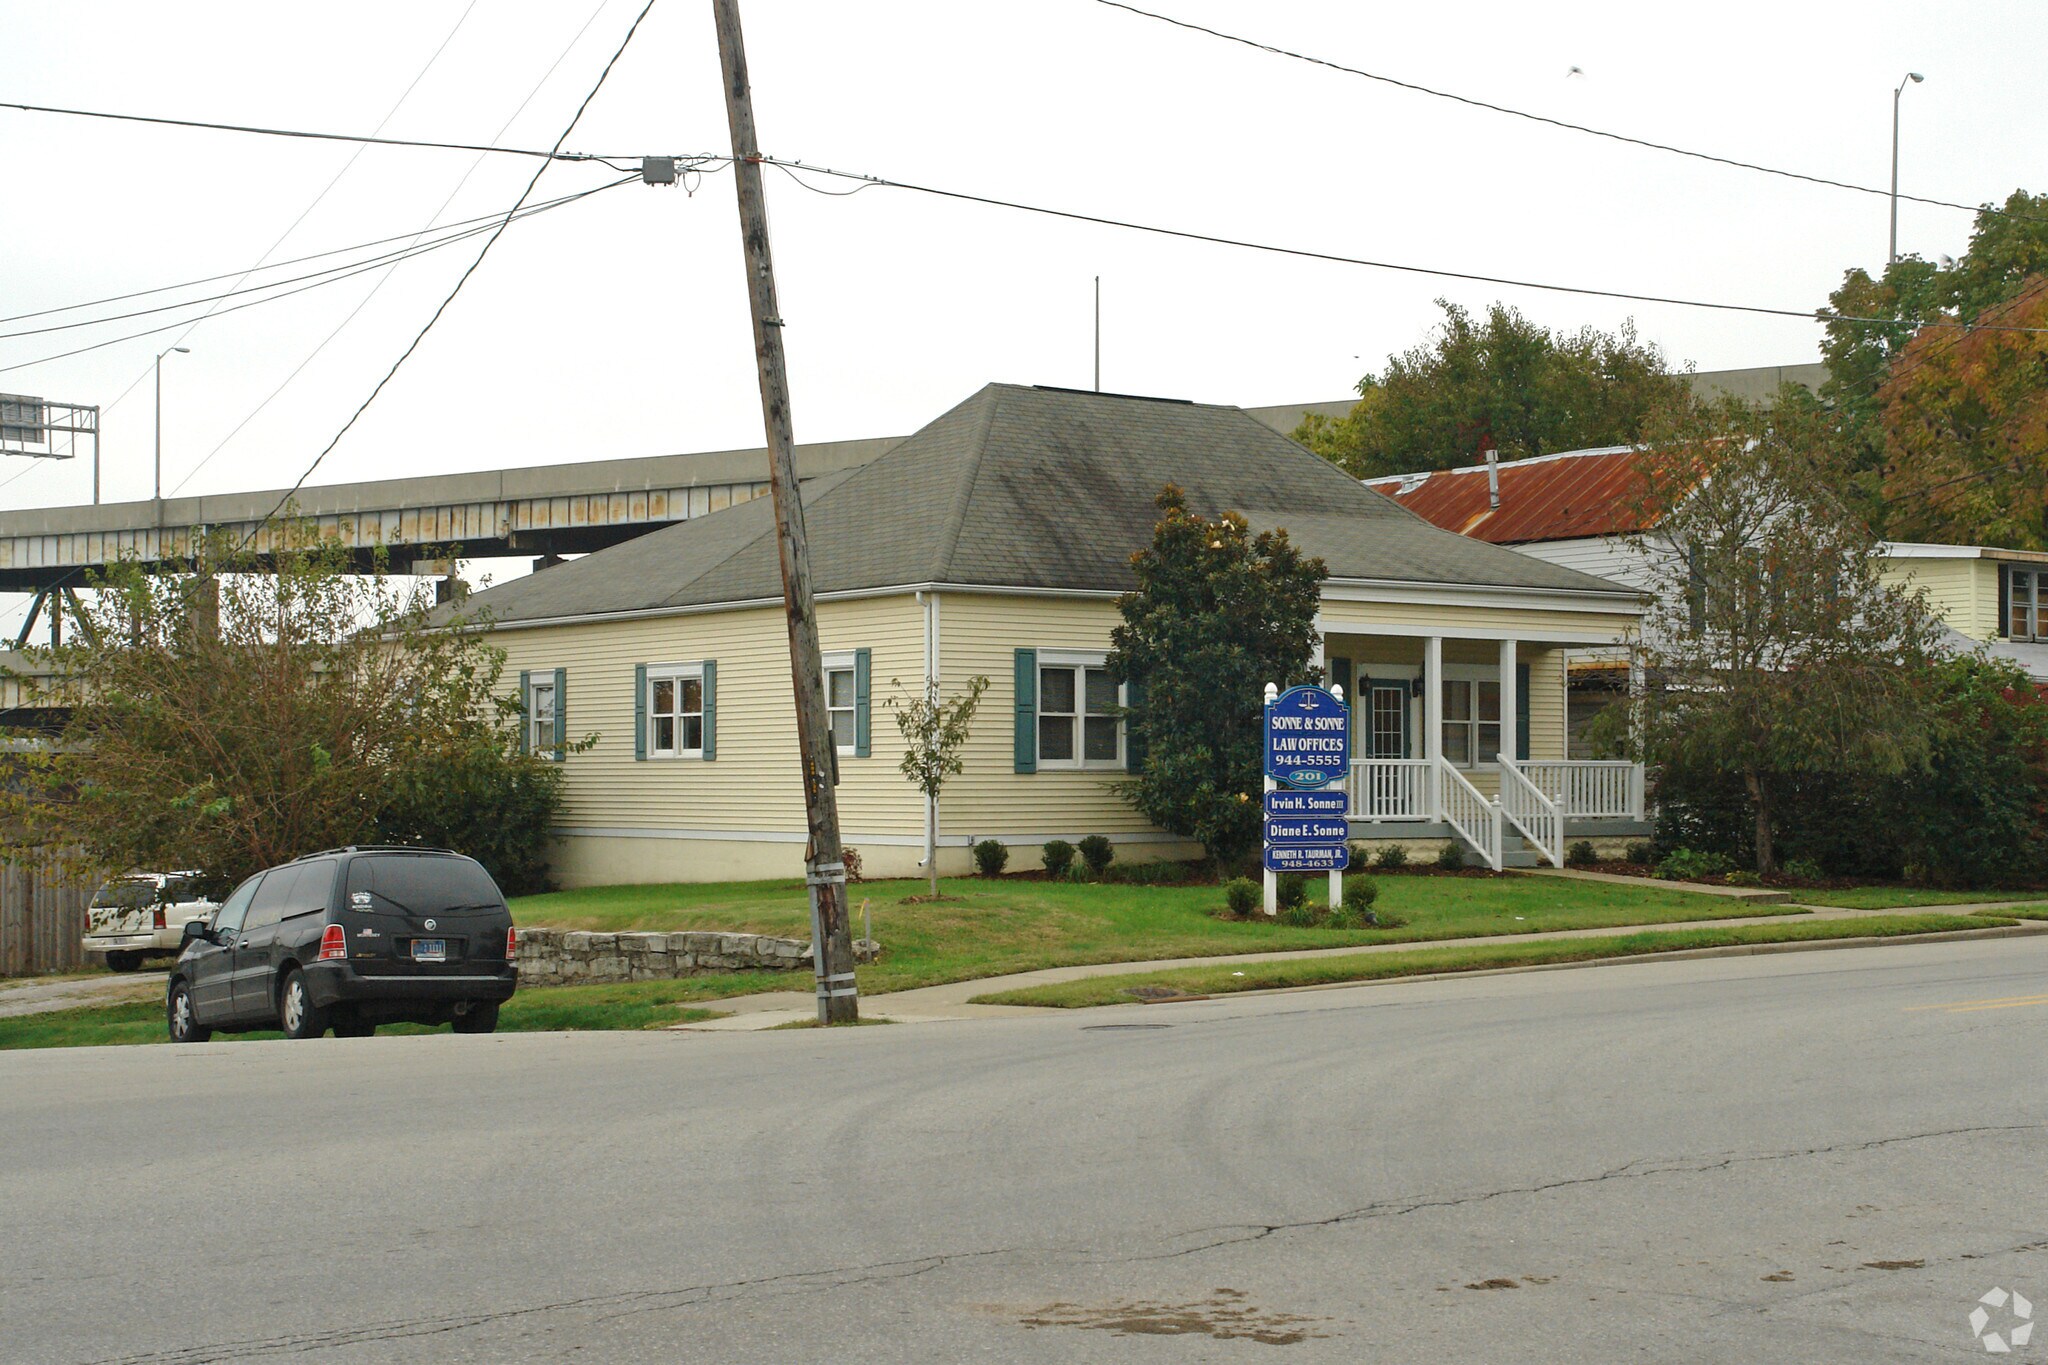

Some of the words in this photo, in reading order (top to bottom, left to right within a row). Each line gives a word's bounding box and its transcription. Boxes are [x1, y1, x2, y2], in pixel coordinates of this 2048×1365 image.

[1272, 717, 1302, 730] SONNE
[1305, 717, 1313, 730] &
[1315, 717, 1344, 730] SONNE
[1273, 738, 1297, 751] LAW
[1298, 738, 1343, 751] OFFICES
[1276, 755, 1340, 766] 944-5555
[1295, 772, 1322, 781] 201
[1272, 797, 1294, 809] Irvin
[1295, 797, 1305, 809] H.
[1308, 797, 1336, 809] Sonne
[1271, 825, 1301, 836] Diane
[1302, 825, 1312, 836] E.
[1313, 824, 1344, 836] Sonne
[1272, 850, 1297, 859] KENNETH
[1281, 860, 1334, 868] 948-4633
